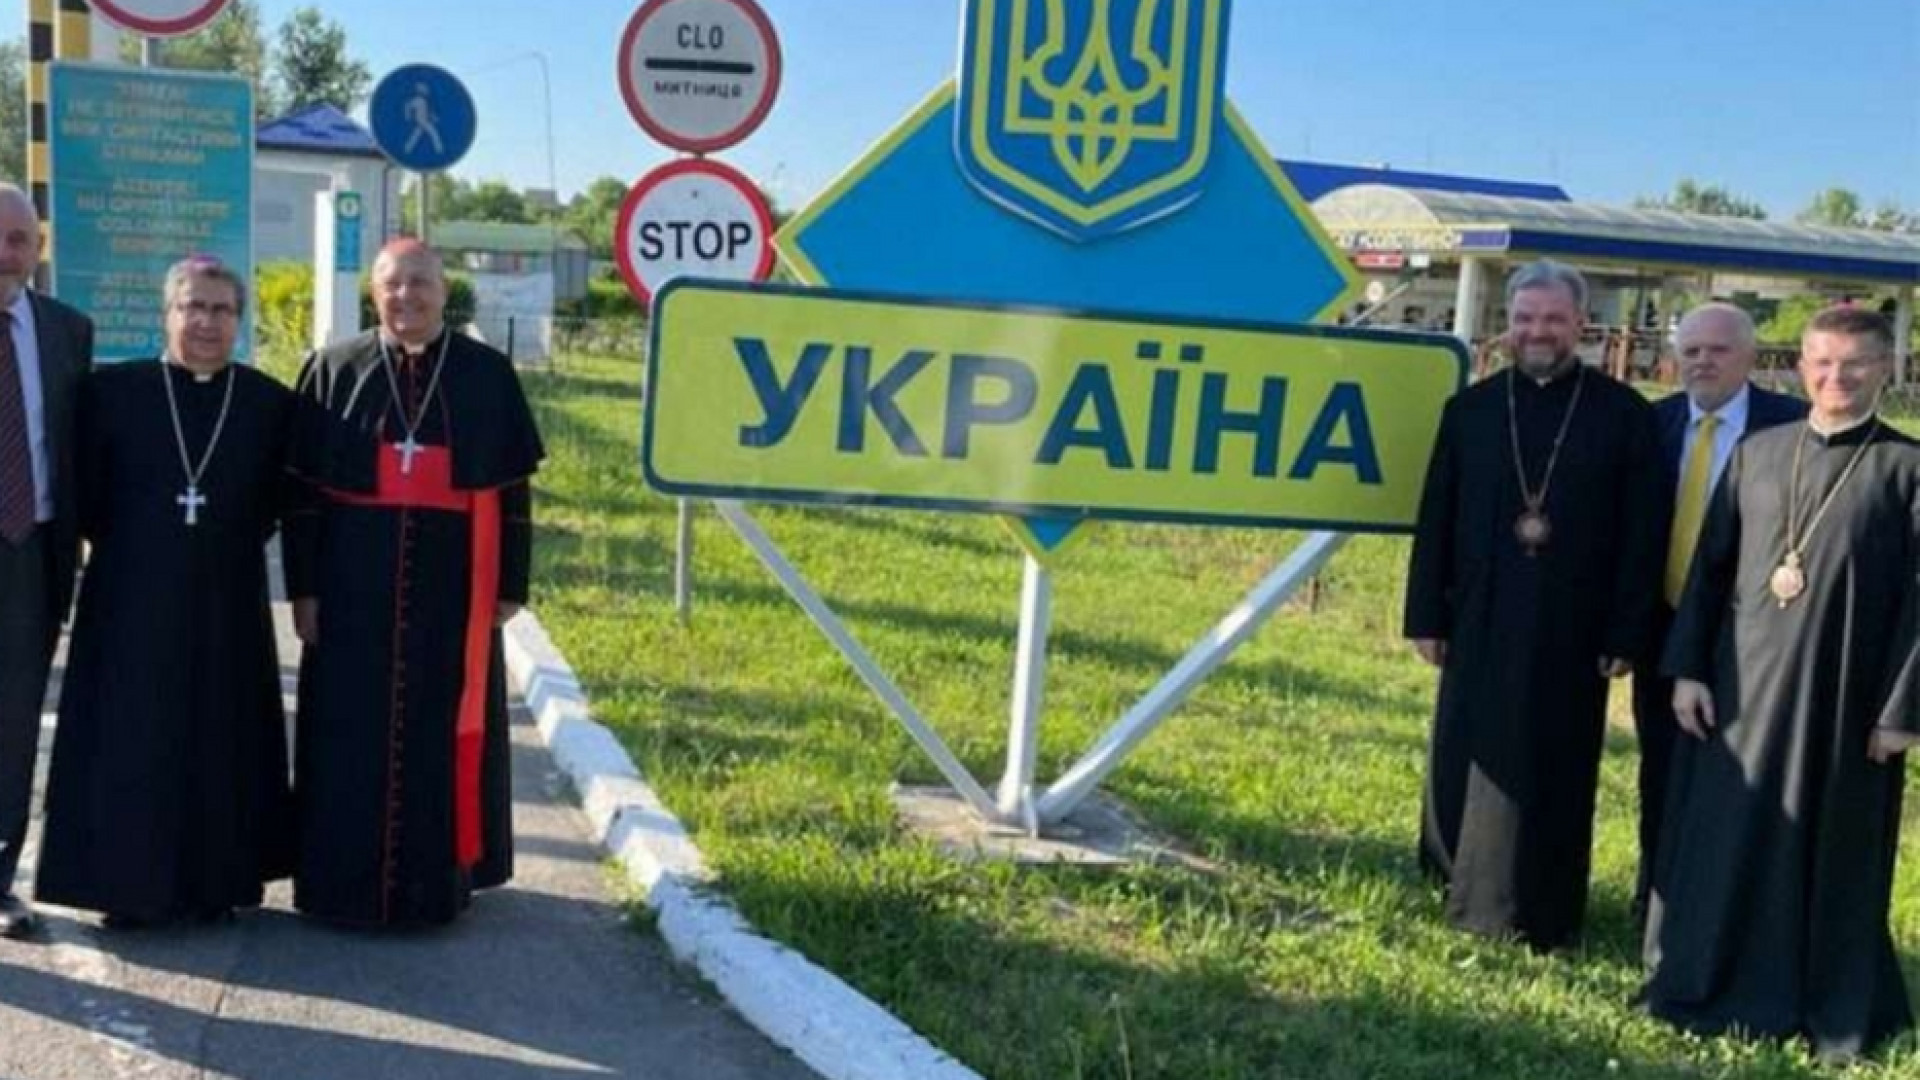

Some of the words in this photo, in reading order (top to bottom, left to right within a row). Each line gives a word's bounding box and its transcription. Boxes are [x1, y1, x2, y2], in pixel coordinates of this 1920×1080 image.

[677, 23, 724, 49] CLO
[639, 221, 752, 260] STOP
[732, 338, 1383, 484] УКРАЇНА
